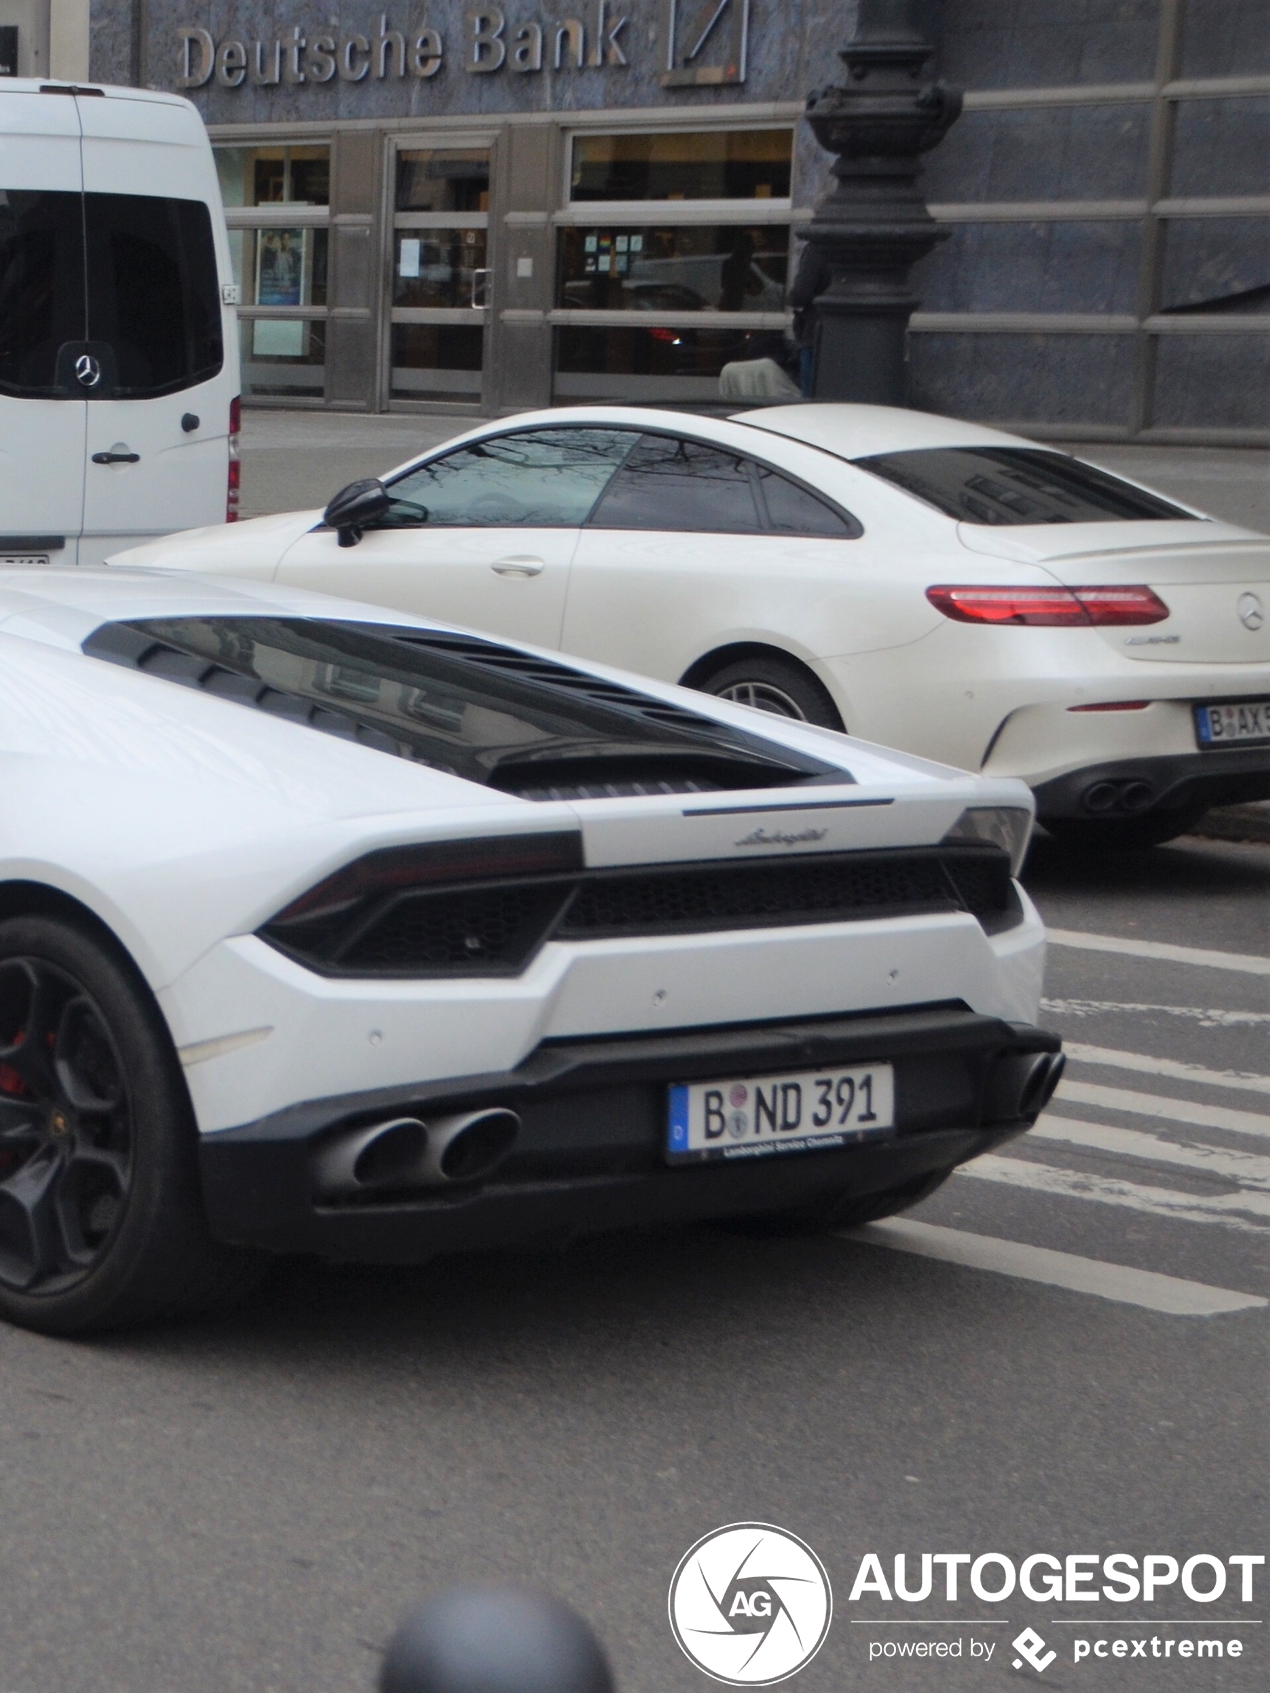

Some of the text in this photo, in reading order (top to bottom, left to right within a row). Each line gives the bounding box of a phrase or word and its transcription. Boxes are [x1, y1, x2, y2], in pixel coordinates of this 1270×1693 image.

[175, 0, 631, 88] Deutsche Bank
[1210, 709, 1224, 737] B
[704, 1074, 877, 1140] B ND 391
